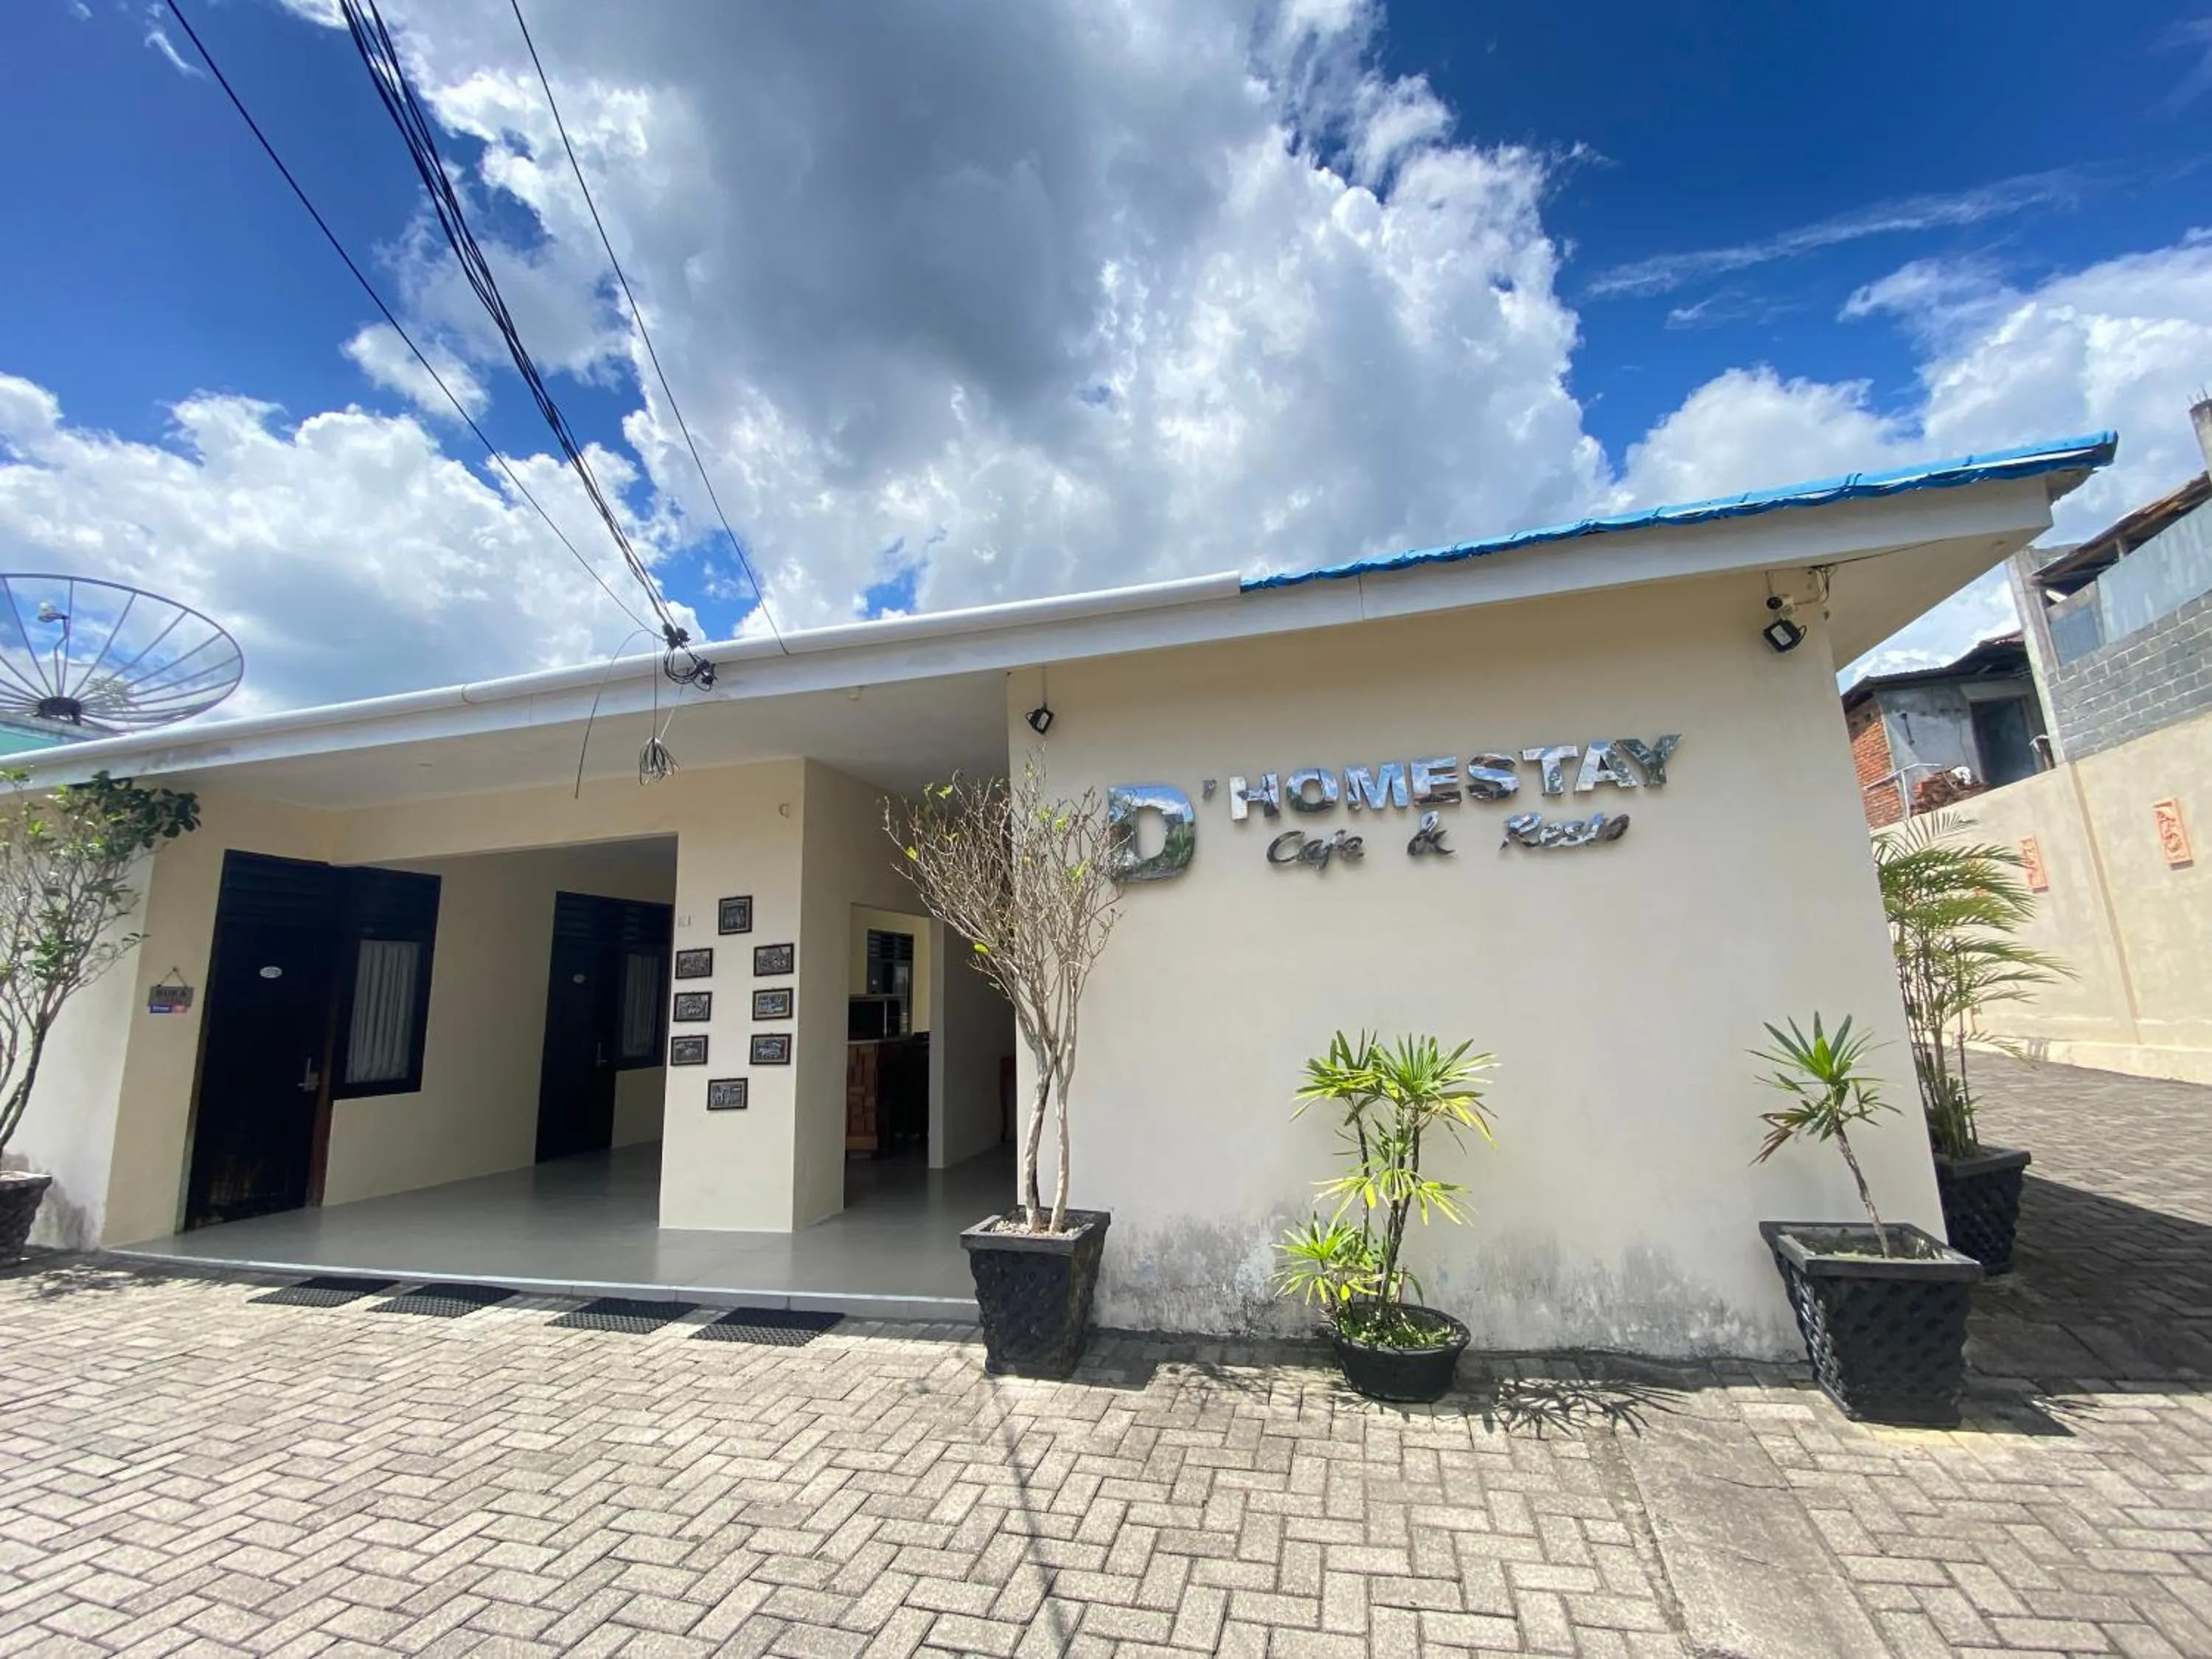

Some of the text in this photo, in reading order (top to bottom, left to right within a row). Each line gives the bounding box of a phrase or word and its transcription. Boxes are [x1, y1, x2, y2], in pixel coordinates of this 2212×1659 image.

[1267, 810, 1630, 870] Cafe & Resto
